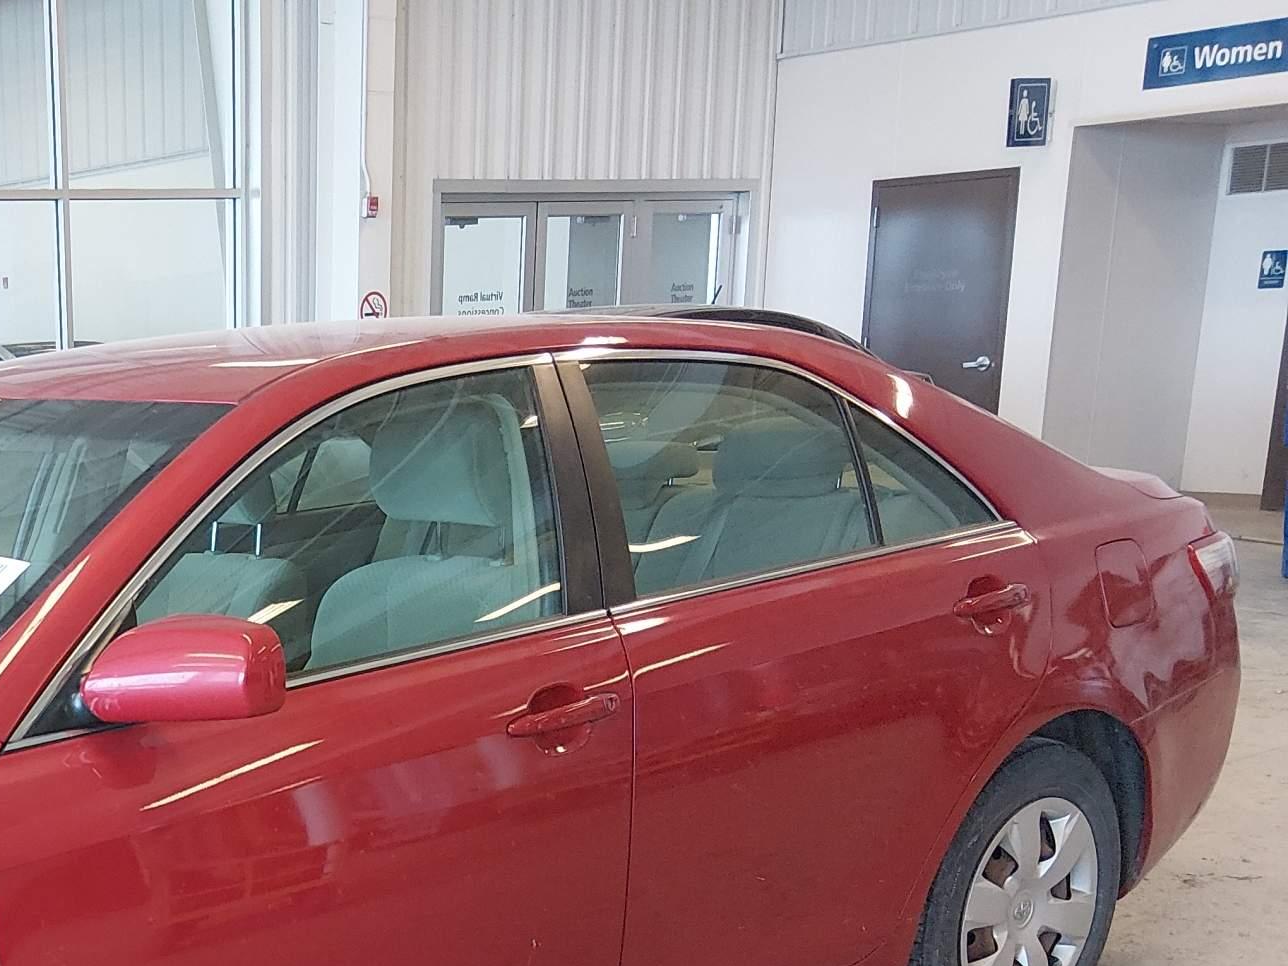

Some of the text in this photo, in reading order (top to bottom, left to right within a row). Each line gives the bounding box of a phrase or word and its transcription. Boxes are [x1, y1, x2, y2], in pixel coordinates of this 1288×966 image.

[1193, 39, 1283, 69] Women
[568, 287, 593, 297] Auction
[672, 282, 694, 292] Auction
